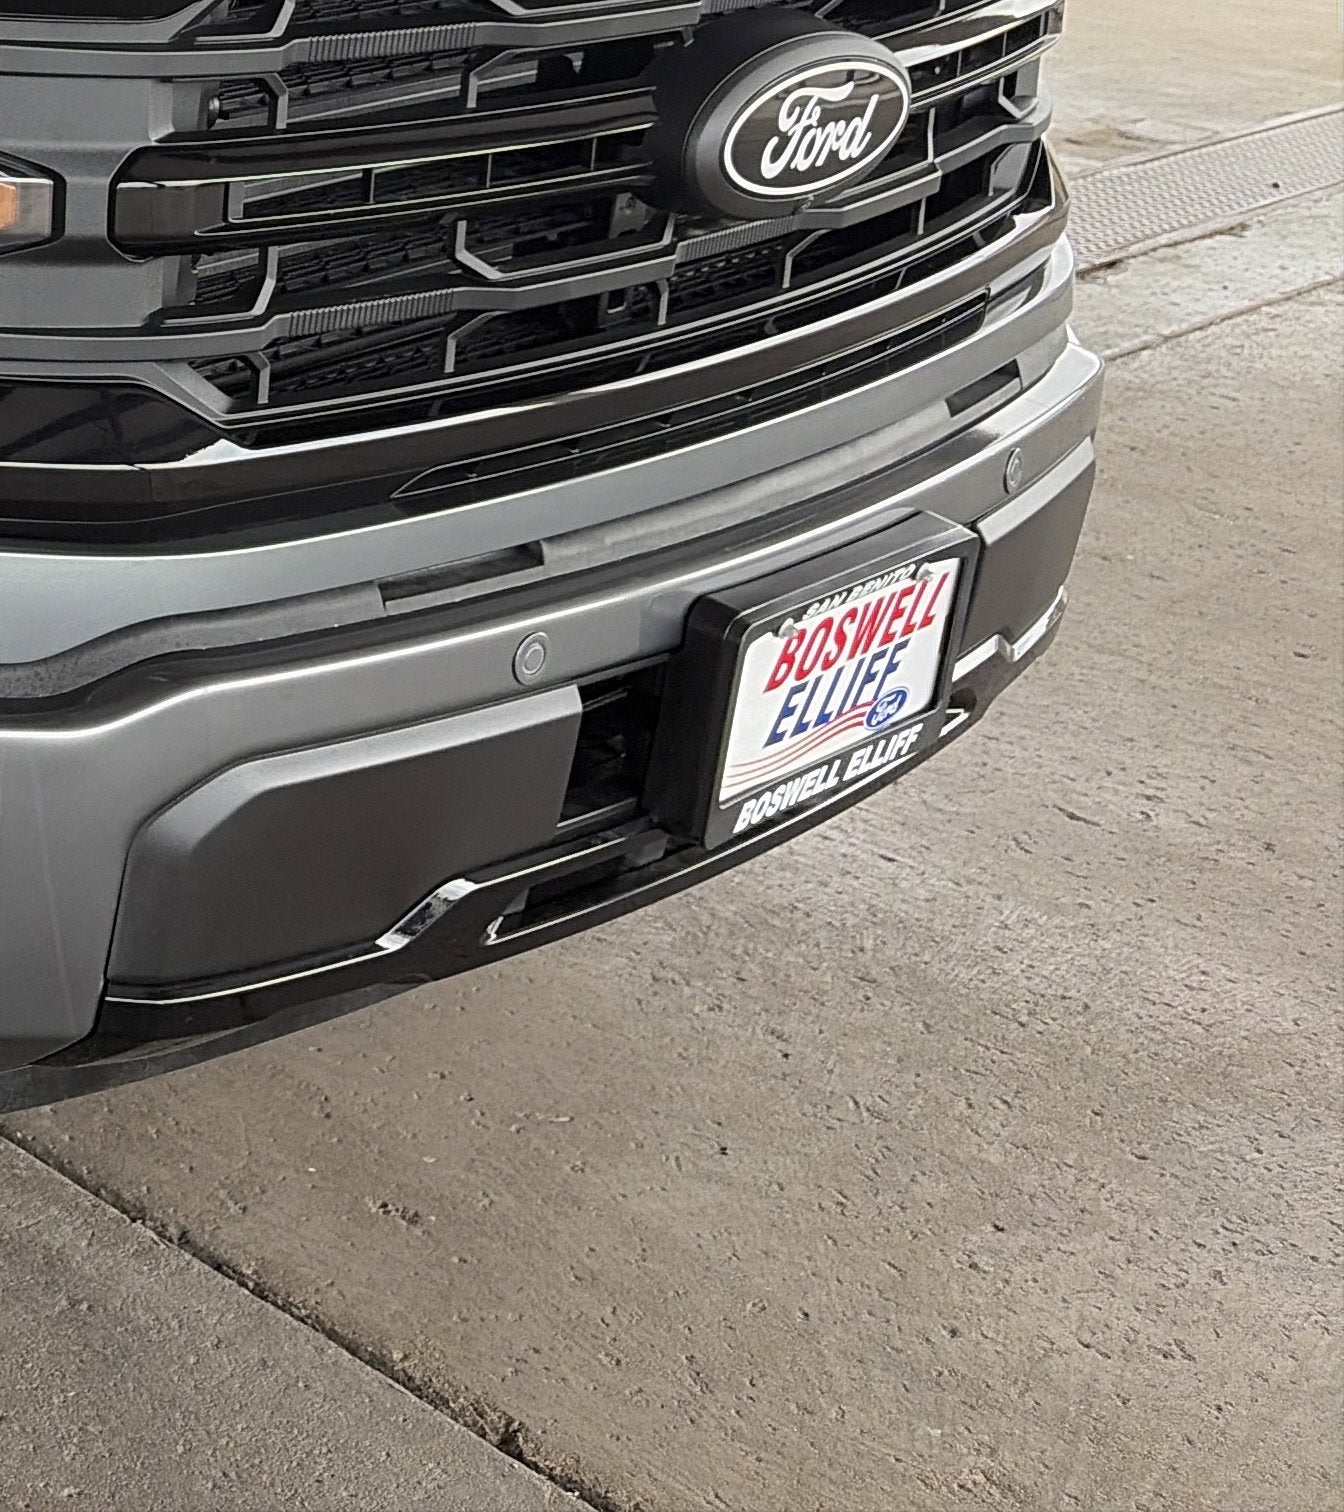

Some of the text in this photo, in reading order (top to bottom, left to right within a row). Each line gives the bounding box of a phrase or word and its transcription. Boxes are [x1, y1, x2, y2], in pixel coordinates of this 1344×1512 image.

[761, 80, 880, 179] Ford
[762, 570, 951, 694] BOSWELL
[802, 563, 917, 621] SAN BENITO
[762, 636, 913, 749] ELLIFF
[870, 692, 904, 727] Ford
[732, 723, 924, 835] BOSWELL ELLIFF
